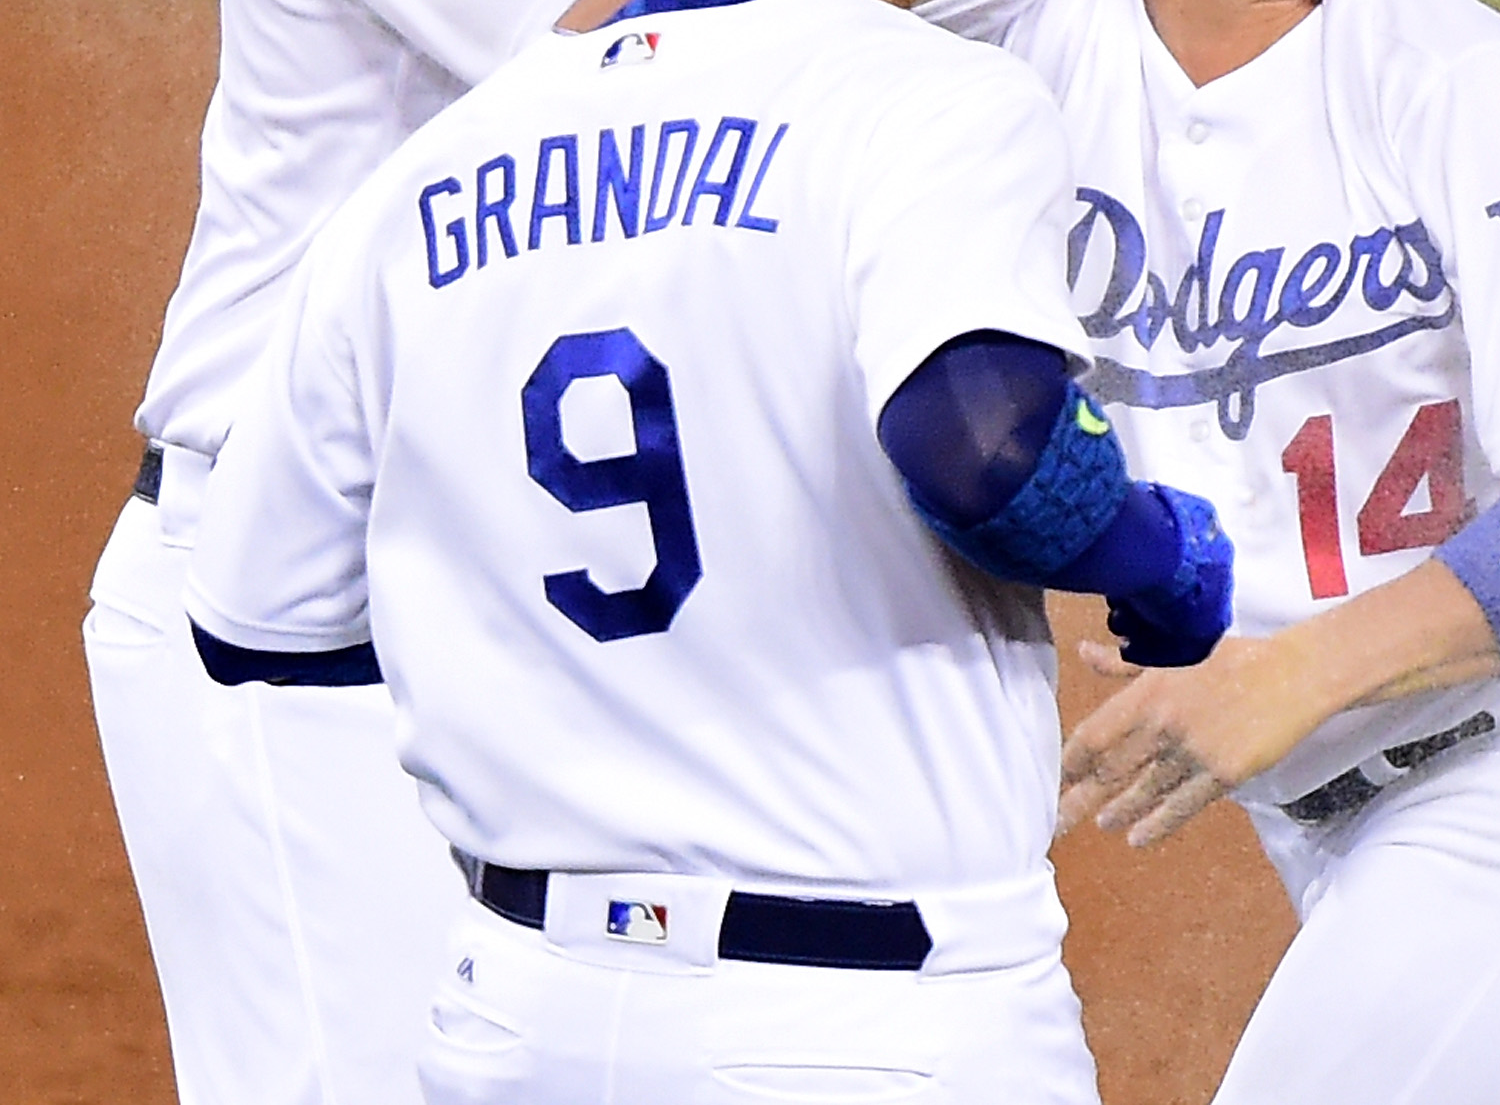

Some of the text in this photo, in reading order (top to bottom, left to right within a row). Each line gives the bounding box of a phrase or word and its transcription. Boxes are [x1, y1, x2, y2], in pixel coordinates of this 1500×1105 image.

[418, 116, 789, 289] GRANDAL
[1067, 187, 1449, 441] Dodgers
[521, 326, 704, 643] 9
[1281, 397, 1478, 601] 14
